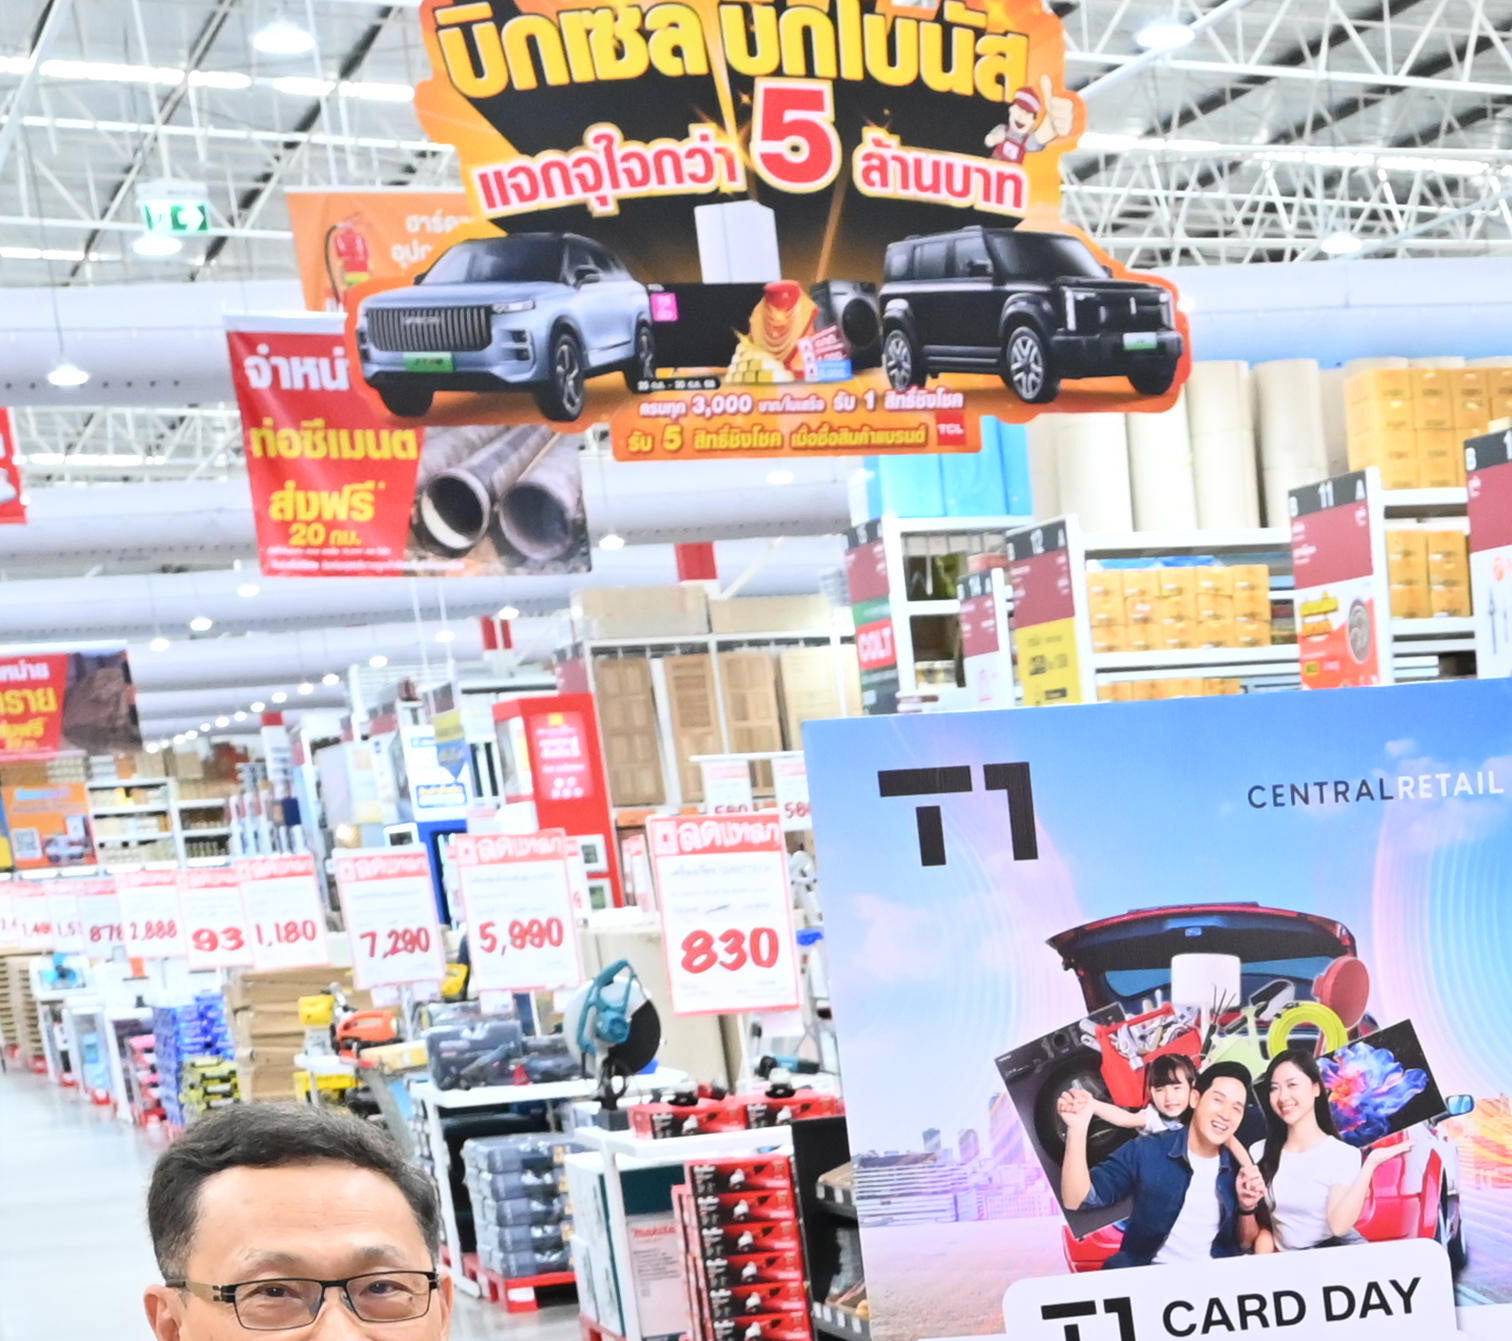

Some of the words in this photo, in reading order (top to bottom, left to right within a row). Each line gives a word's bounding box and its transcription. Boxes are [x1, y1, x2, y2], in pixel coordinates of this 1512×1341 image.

[758, 84, 837, 185] 5
[477, 131, 739, 214] แจกจุใจกว่า
[859, 136, 1024, 209] ล้านบาท
[691, 394, 753, 417] 3,000
[863, 390, 876, 411] 1
[628, 430, 653, 453] รับ
[662, 425, 683, 452] 5
[937, 423, 964, 436] TCL
[290, 523, 326, 546] 20
[255, 918, 318, 951] 1,180
[680, 926, 780, 975] 830
[1161, 1290, 1306, 1338] CARD
[1323, 1276, 1424, 1324] DAY
